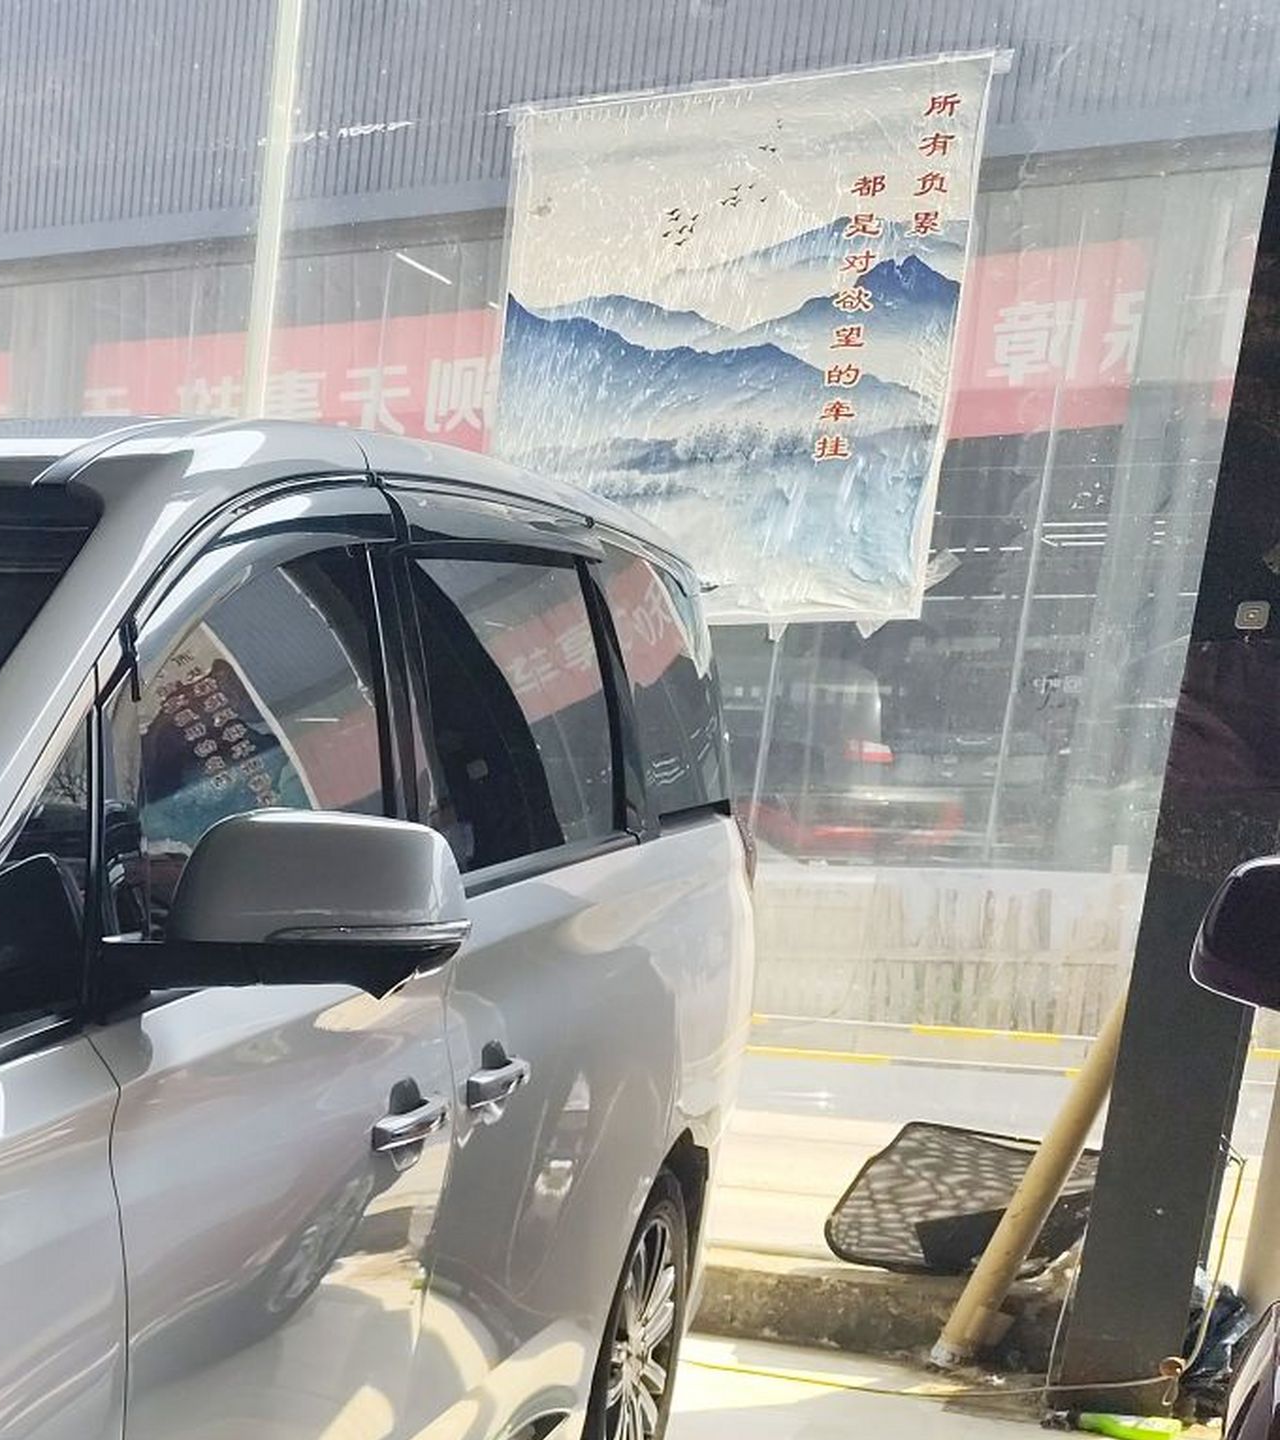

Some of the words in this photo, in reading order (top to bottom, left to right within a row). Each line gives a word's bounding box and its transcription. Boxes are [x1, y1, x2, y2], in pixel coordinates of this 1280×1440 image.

[908, 92, 961, 236] 所有负累
[815, 173, 887, 460] 都是对欲望的牵挂
